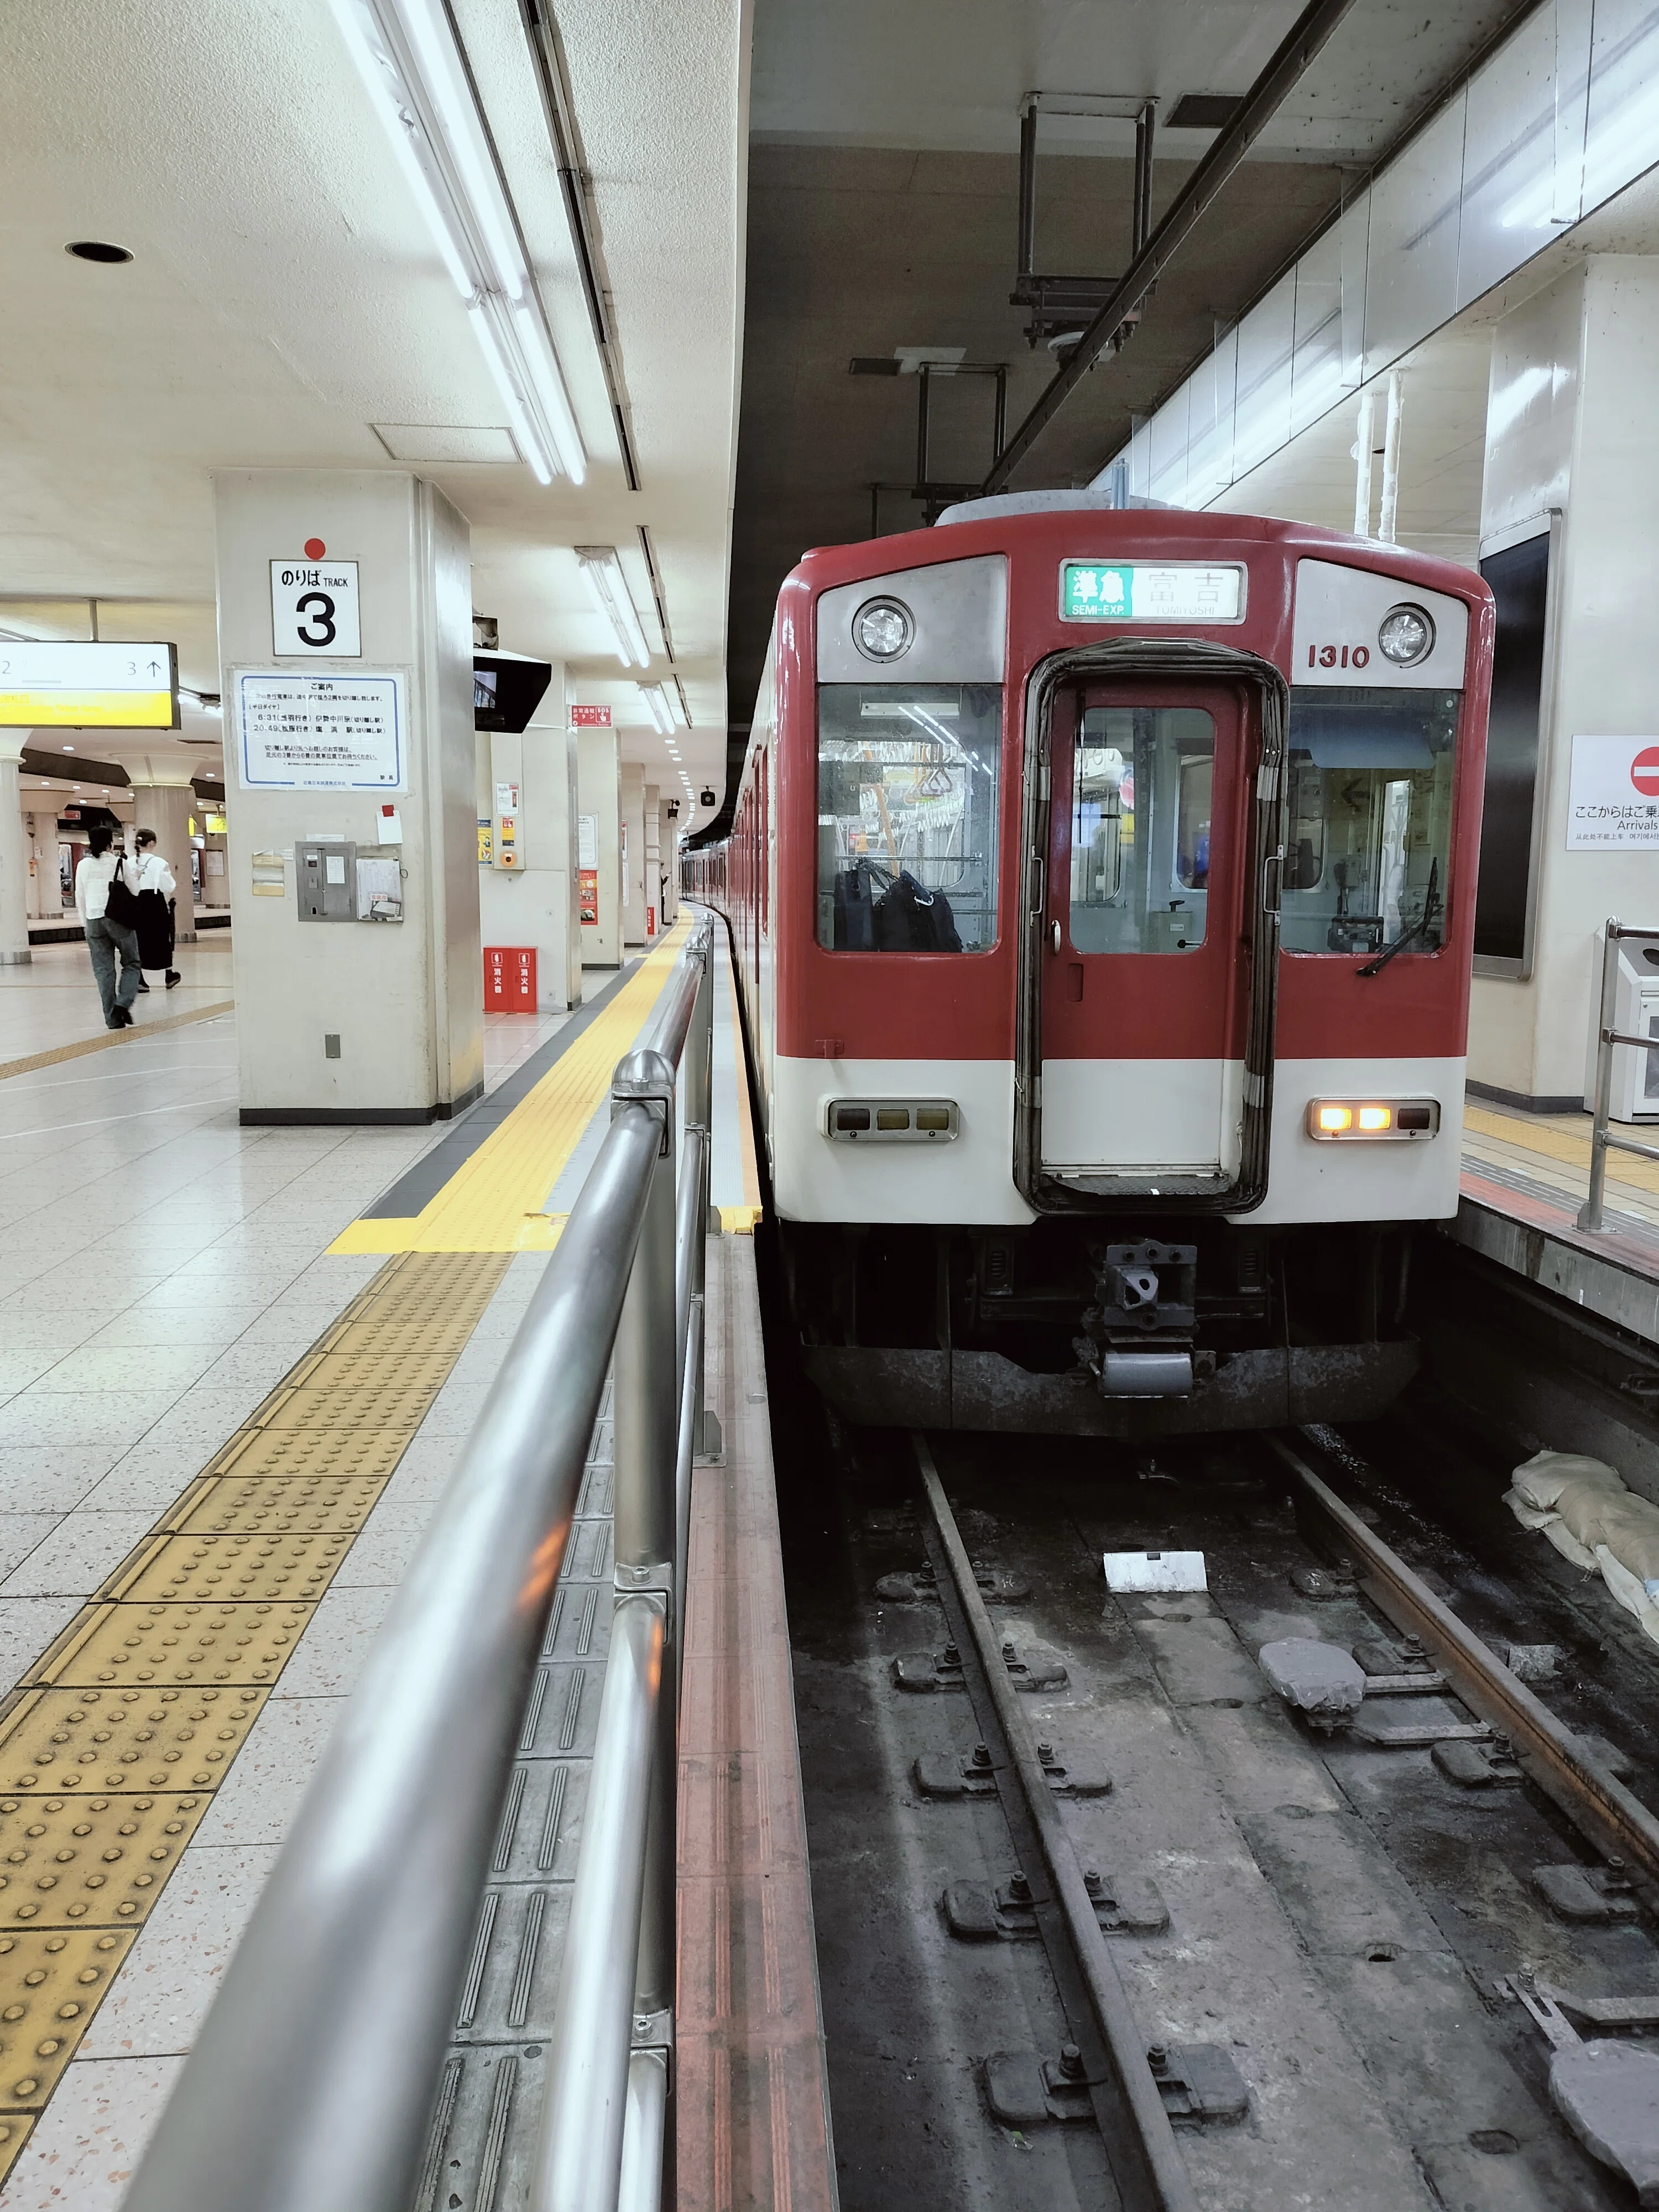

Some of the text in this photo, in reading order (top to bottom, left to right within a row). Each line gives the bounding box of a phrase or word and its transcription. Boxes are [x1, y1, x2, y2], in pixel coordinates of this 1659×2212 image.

[281, 570, 348, 587] のりば TRACK
[1149, 572, 1223, 602] 富吉
[1072, 604, 1214, 615] SEMI-EXP. TOMIYOSHI
[296, 592, 336, 647] 3
[1308, 645, 1370, 668] 1310
[2, 660, 11, 674] 2
[127, 662, 136, 675] 3
[1575, 805, 1659, 818] ここからはご乗
[1617, 820, 1658, 830] Arrivals
